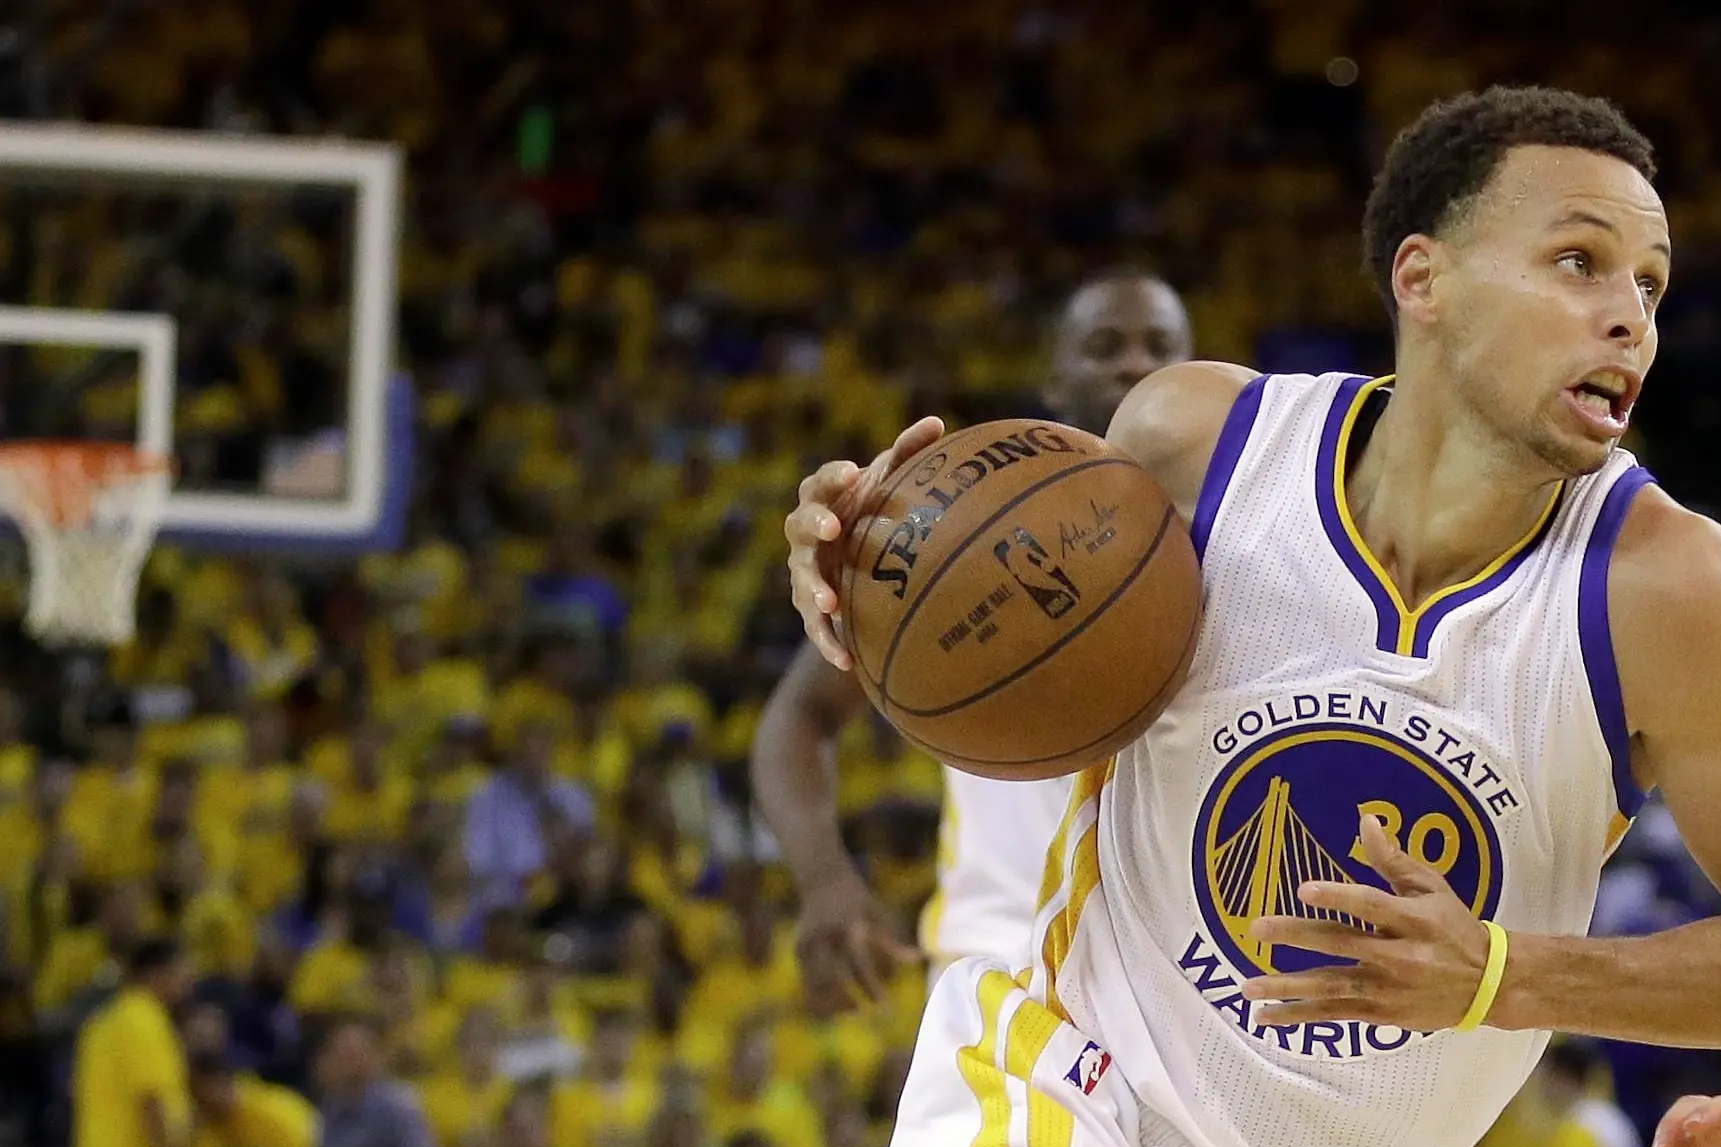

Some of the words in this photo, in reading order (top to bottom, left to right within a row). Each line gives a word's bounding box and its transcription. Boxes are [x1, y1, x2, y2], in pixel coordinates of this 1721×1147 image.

[872, 427, 1075, 599] SPALDING
[1212, 692, 1388, 755] GOLDEN
[1403, 714, 1520, 817] STATE
[1177, 931, 1435, 1058] WARRIO
